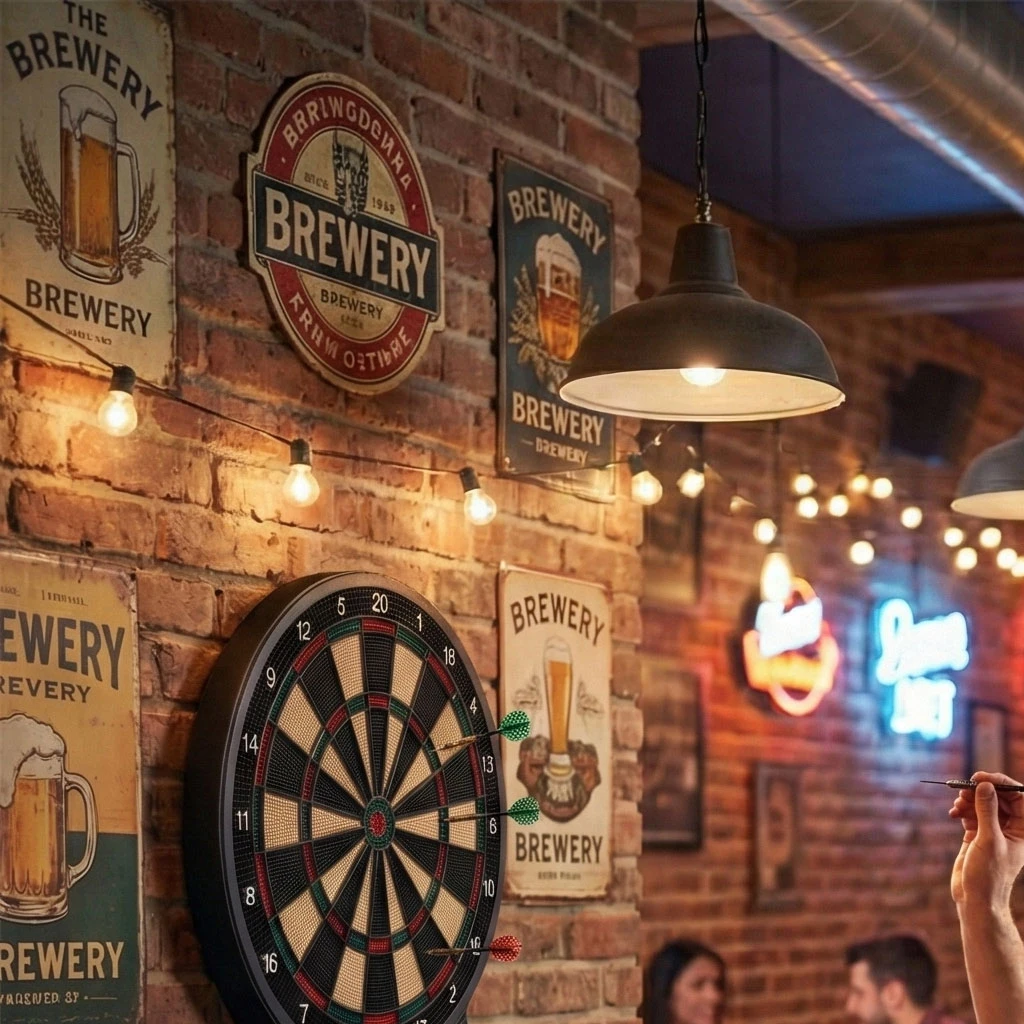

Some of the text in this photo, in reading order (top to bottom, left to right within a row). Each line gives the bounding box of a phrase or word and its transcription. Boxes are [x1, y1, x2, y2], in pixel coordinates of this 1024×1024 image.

[64, 0, 108, 37] THE
[6, 31, 163, 121] BREWERY
[508, 185, 606, 255] BREWERY
[265, 186, 431, 300] BREWERY
[25, 278, 152, 338] BREWERY
[512, 391, 604, 446] BREWERY
[337, 596, 346, 616] 5
[372, 592, 388, 614] 20
[416, 613, 422, 632] 1
[510, 592, 605, 647] BREWERY
[296, 620, 311, 641] 12
[443, 646, 456, 666] 18
[266, 667, 276, 689] 9
[469, 697, 477, 715] 4
[242, 732, 259, 755] 14
[482, 755, 494, 774] 13
[235, 810, 249, 831] 11
[489, 817, 498, 835] 6
[515, 832, 603, 864] BREWERY
[245, 886, 256, 906] 8
[483, 879, 495, 897] 10
[262, 952, 278, 974] 16
[449, 984, 457, 1004] 2
[299, 1003, 309, 1024] 7
